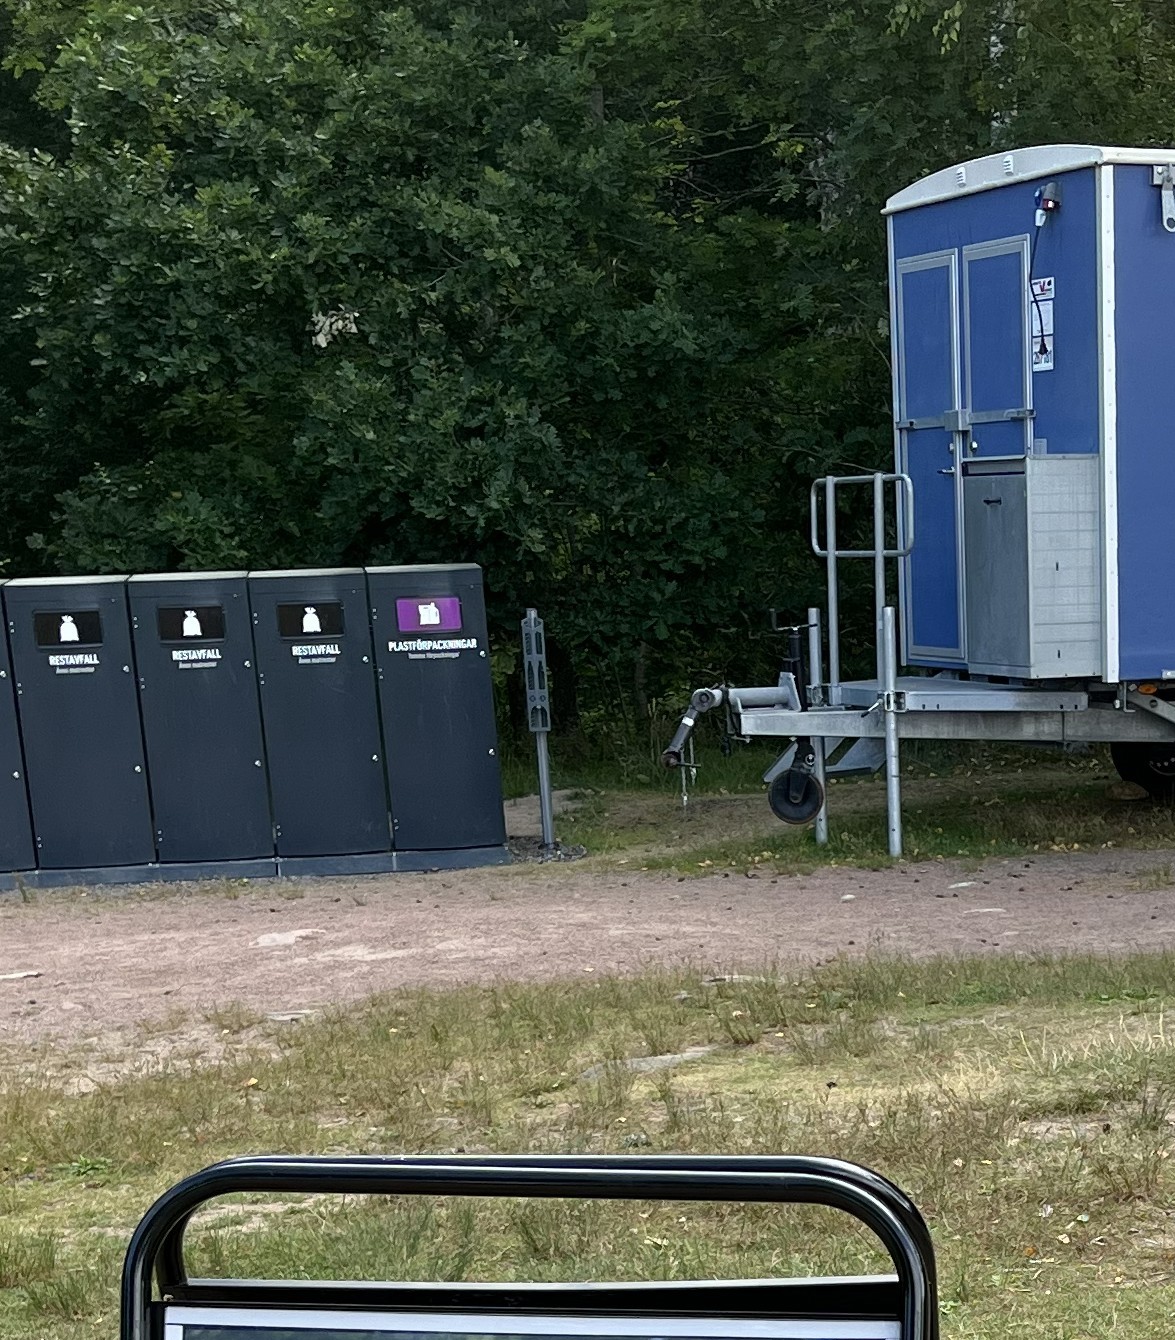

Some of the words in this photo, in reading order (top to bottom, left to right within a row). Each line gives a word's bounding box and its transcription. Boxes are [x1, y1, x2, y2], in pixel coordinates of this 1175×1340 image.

[292, 644, 341, 656] RESTAVFALL
[388, 638, 478, 652] PLASTFÖRPACKNINGAR
[49, 653, 100, 666] RESTAVFALL
[172, 649, 222, 661] RESTAVFALL
